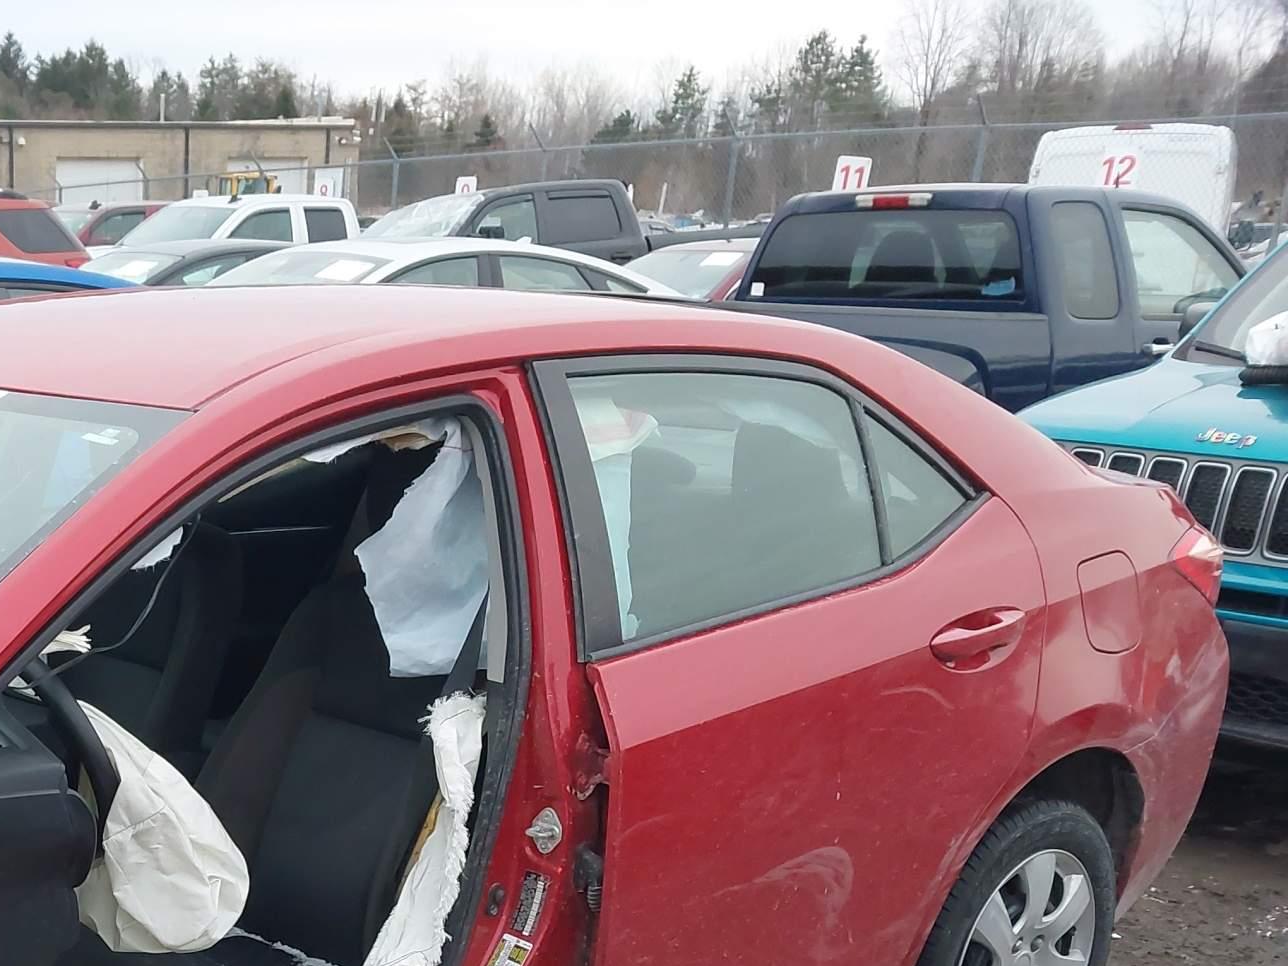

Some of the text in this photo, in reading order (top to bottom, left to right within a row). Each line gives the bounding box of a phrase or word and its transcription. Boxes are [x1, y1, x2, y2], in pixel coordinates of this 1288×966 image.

[840, 164, 865, 189] 11
[1102, 154, 1137, 187] 12
[1195, 426, 1258, 449] Jeep
